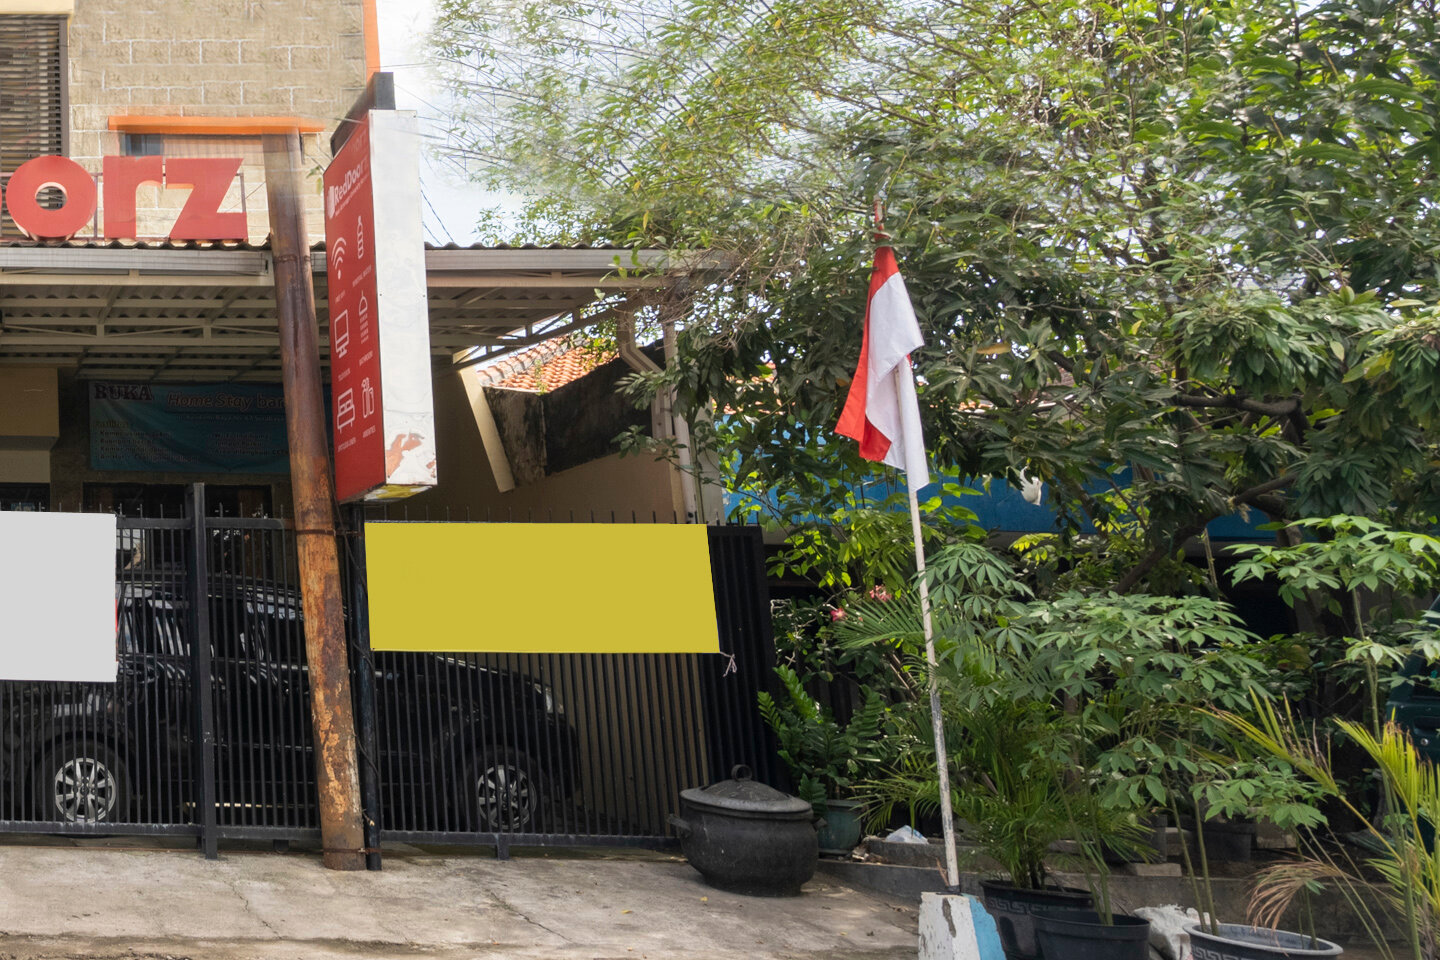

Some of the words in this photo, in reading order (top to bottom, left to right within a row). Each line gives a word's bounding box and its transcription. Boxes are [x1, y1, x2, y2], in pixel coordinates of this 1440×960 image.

[94, 383, 153, 401] BUKA
[167, 391, 213, 408] Home
[215, 391, 253, 412] Stay
[256, 392, 286, 409] bar
